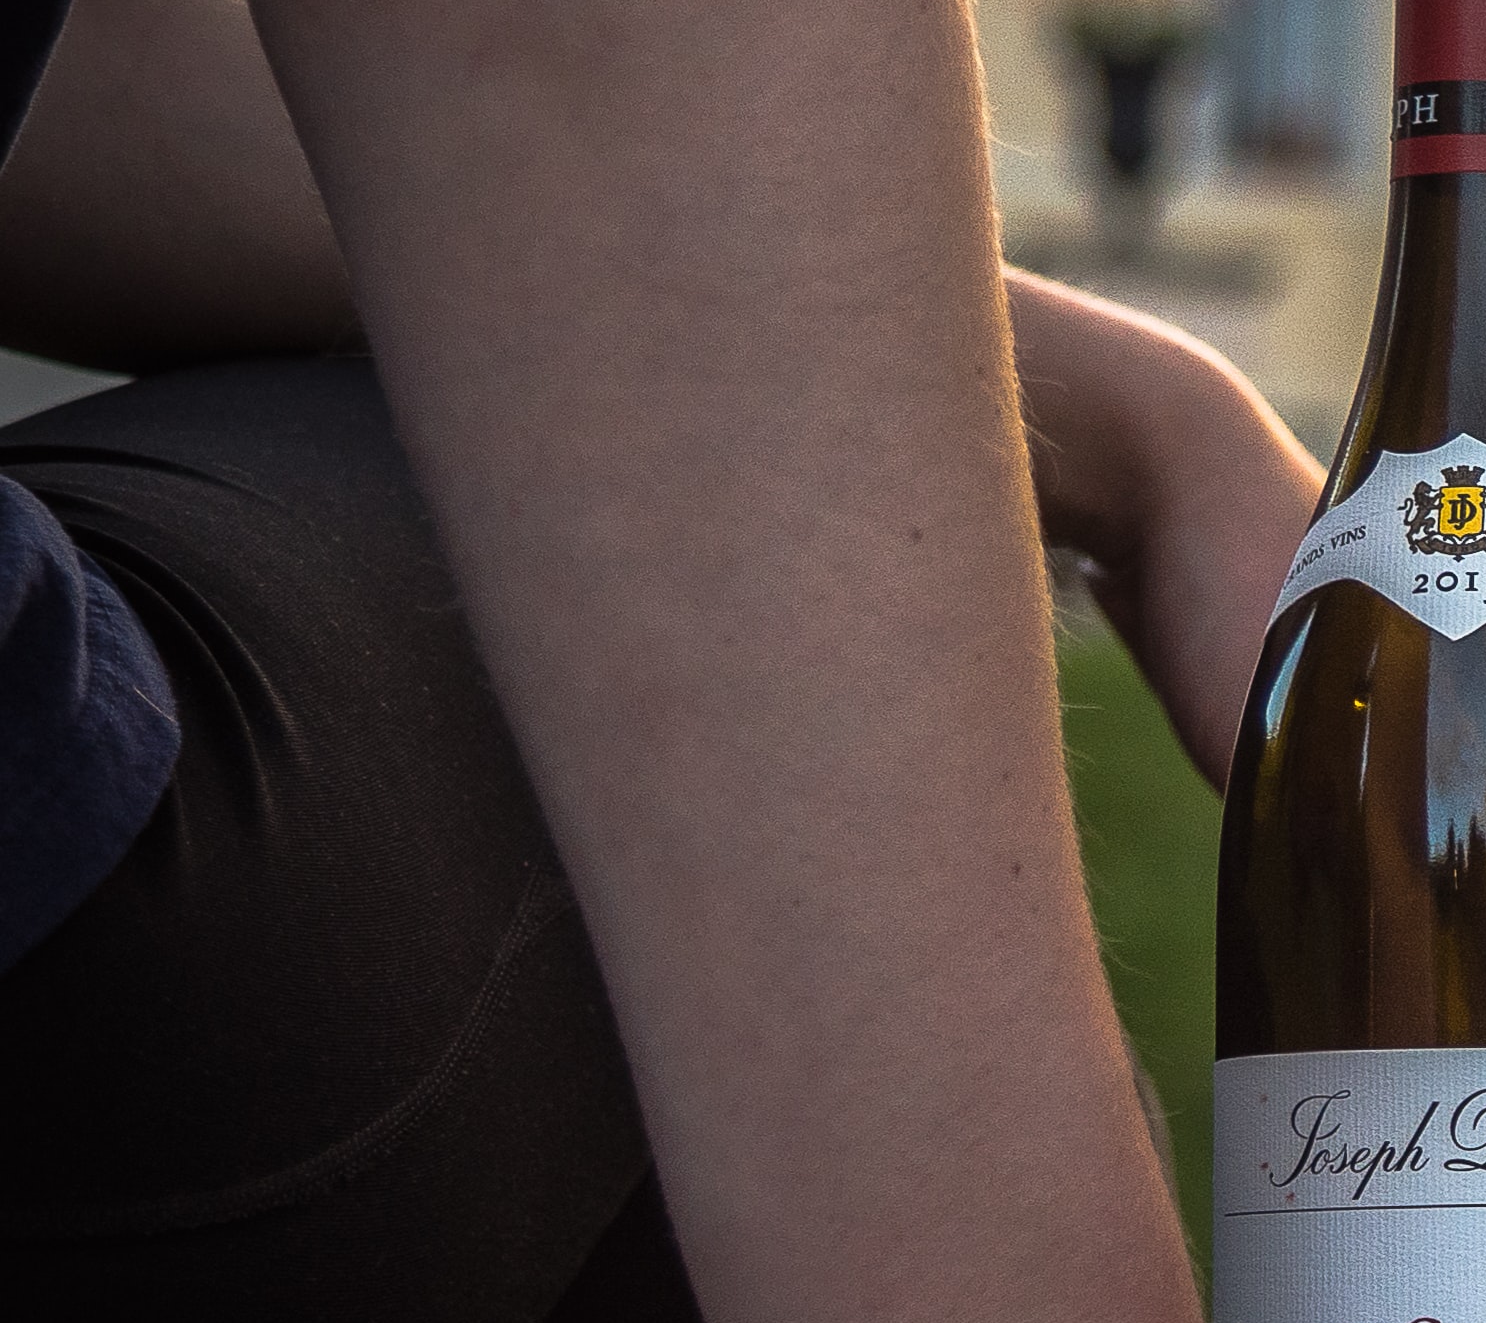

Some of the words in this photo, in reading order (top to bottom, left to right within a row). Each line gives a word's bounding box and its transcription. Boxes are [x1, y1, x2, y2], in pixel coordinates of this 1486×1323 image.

[1290, 544, 1325, 579] ANDS
[1331, 525, 1367, 550] VINS
[1270, 1089, 1441, 1201] Joseph
